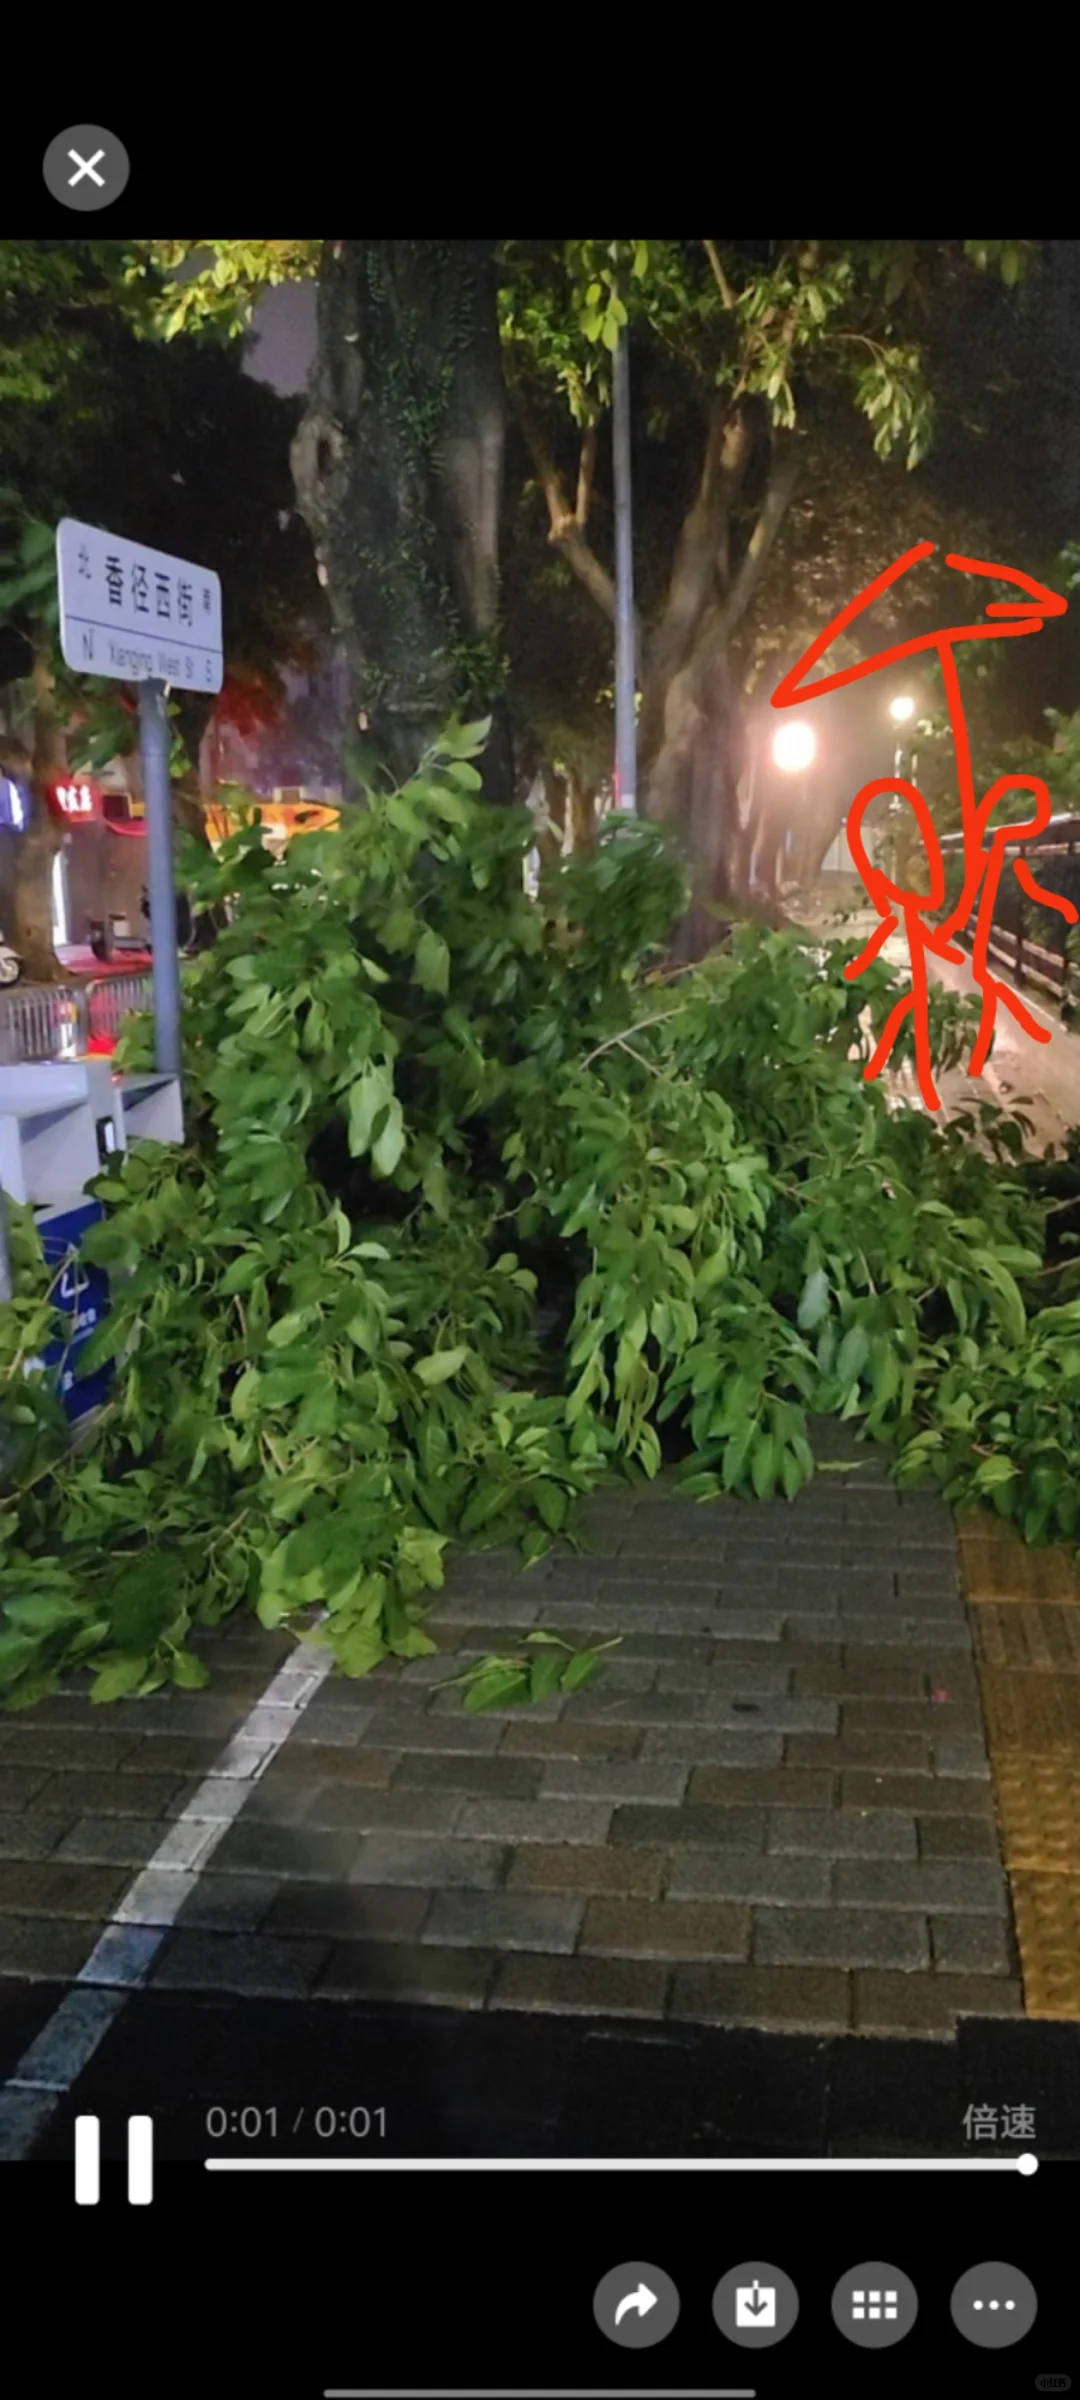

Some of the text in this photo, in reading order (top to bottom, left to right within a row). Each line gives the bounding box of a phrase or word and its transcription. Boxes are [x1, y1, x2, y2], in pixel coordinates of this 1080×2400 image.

[77, 543, 92, 580] 北
[104, 555, 194, 628] 香径西街
[82, 627, 95, 661] N
[204, 658, 213, 684] S
